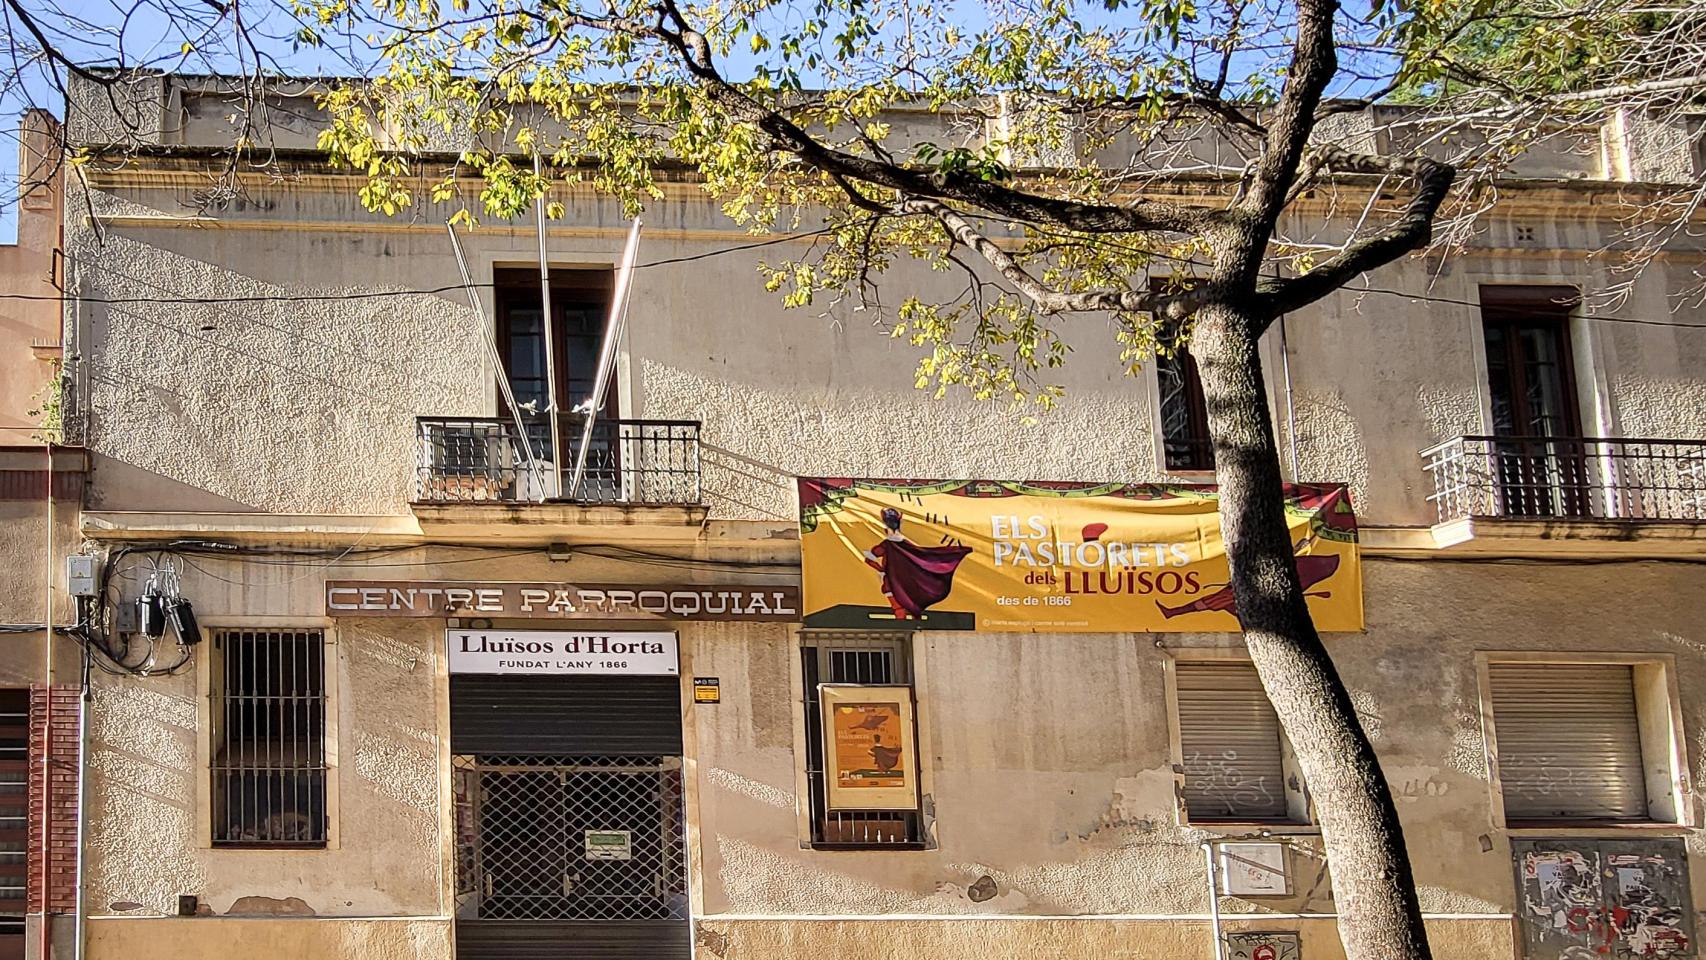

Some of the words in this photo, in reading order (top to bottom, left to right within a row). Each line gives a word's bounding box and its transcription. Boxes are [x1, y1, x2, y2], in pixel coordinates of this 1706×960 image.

[991, 515, 1047, 540] ELS
[993, 541, 1191, 567] PASTORETS
[1024, 571, 1057, 585] dels
[1064, 566, 1200, 595] LLUÏSOS
[328, 587, 504, 612] CENTRE
[520, 589, 796, 617] PARROQUIAL
[996, 595, 1020, 606] des
[1023, 595, 1039, 606] de
[1043, 595, 1072, 606] 1866
[460, 635, 554, 653] Lluïsos
[564, 636, 665, 654] d'Horta
[499, 660, 550, 668] FUNDAT
